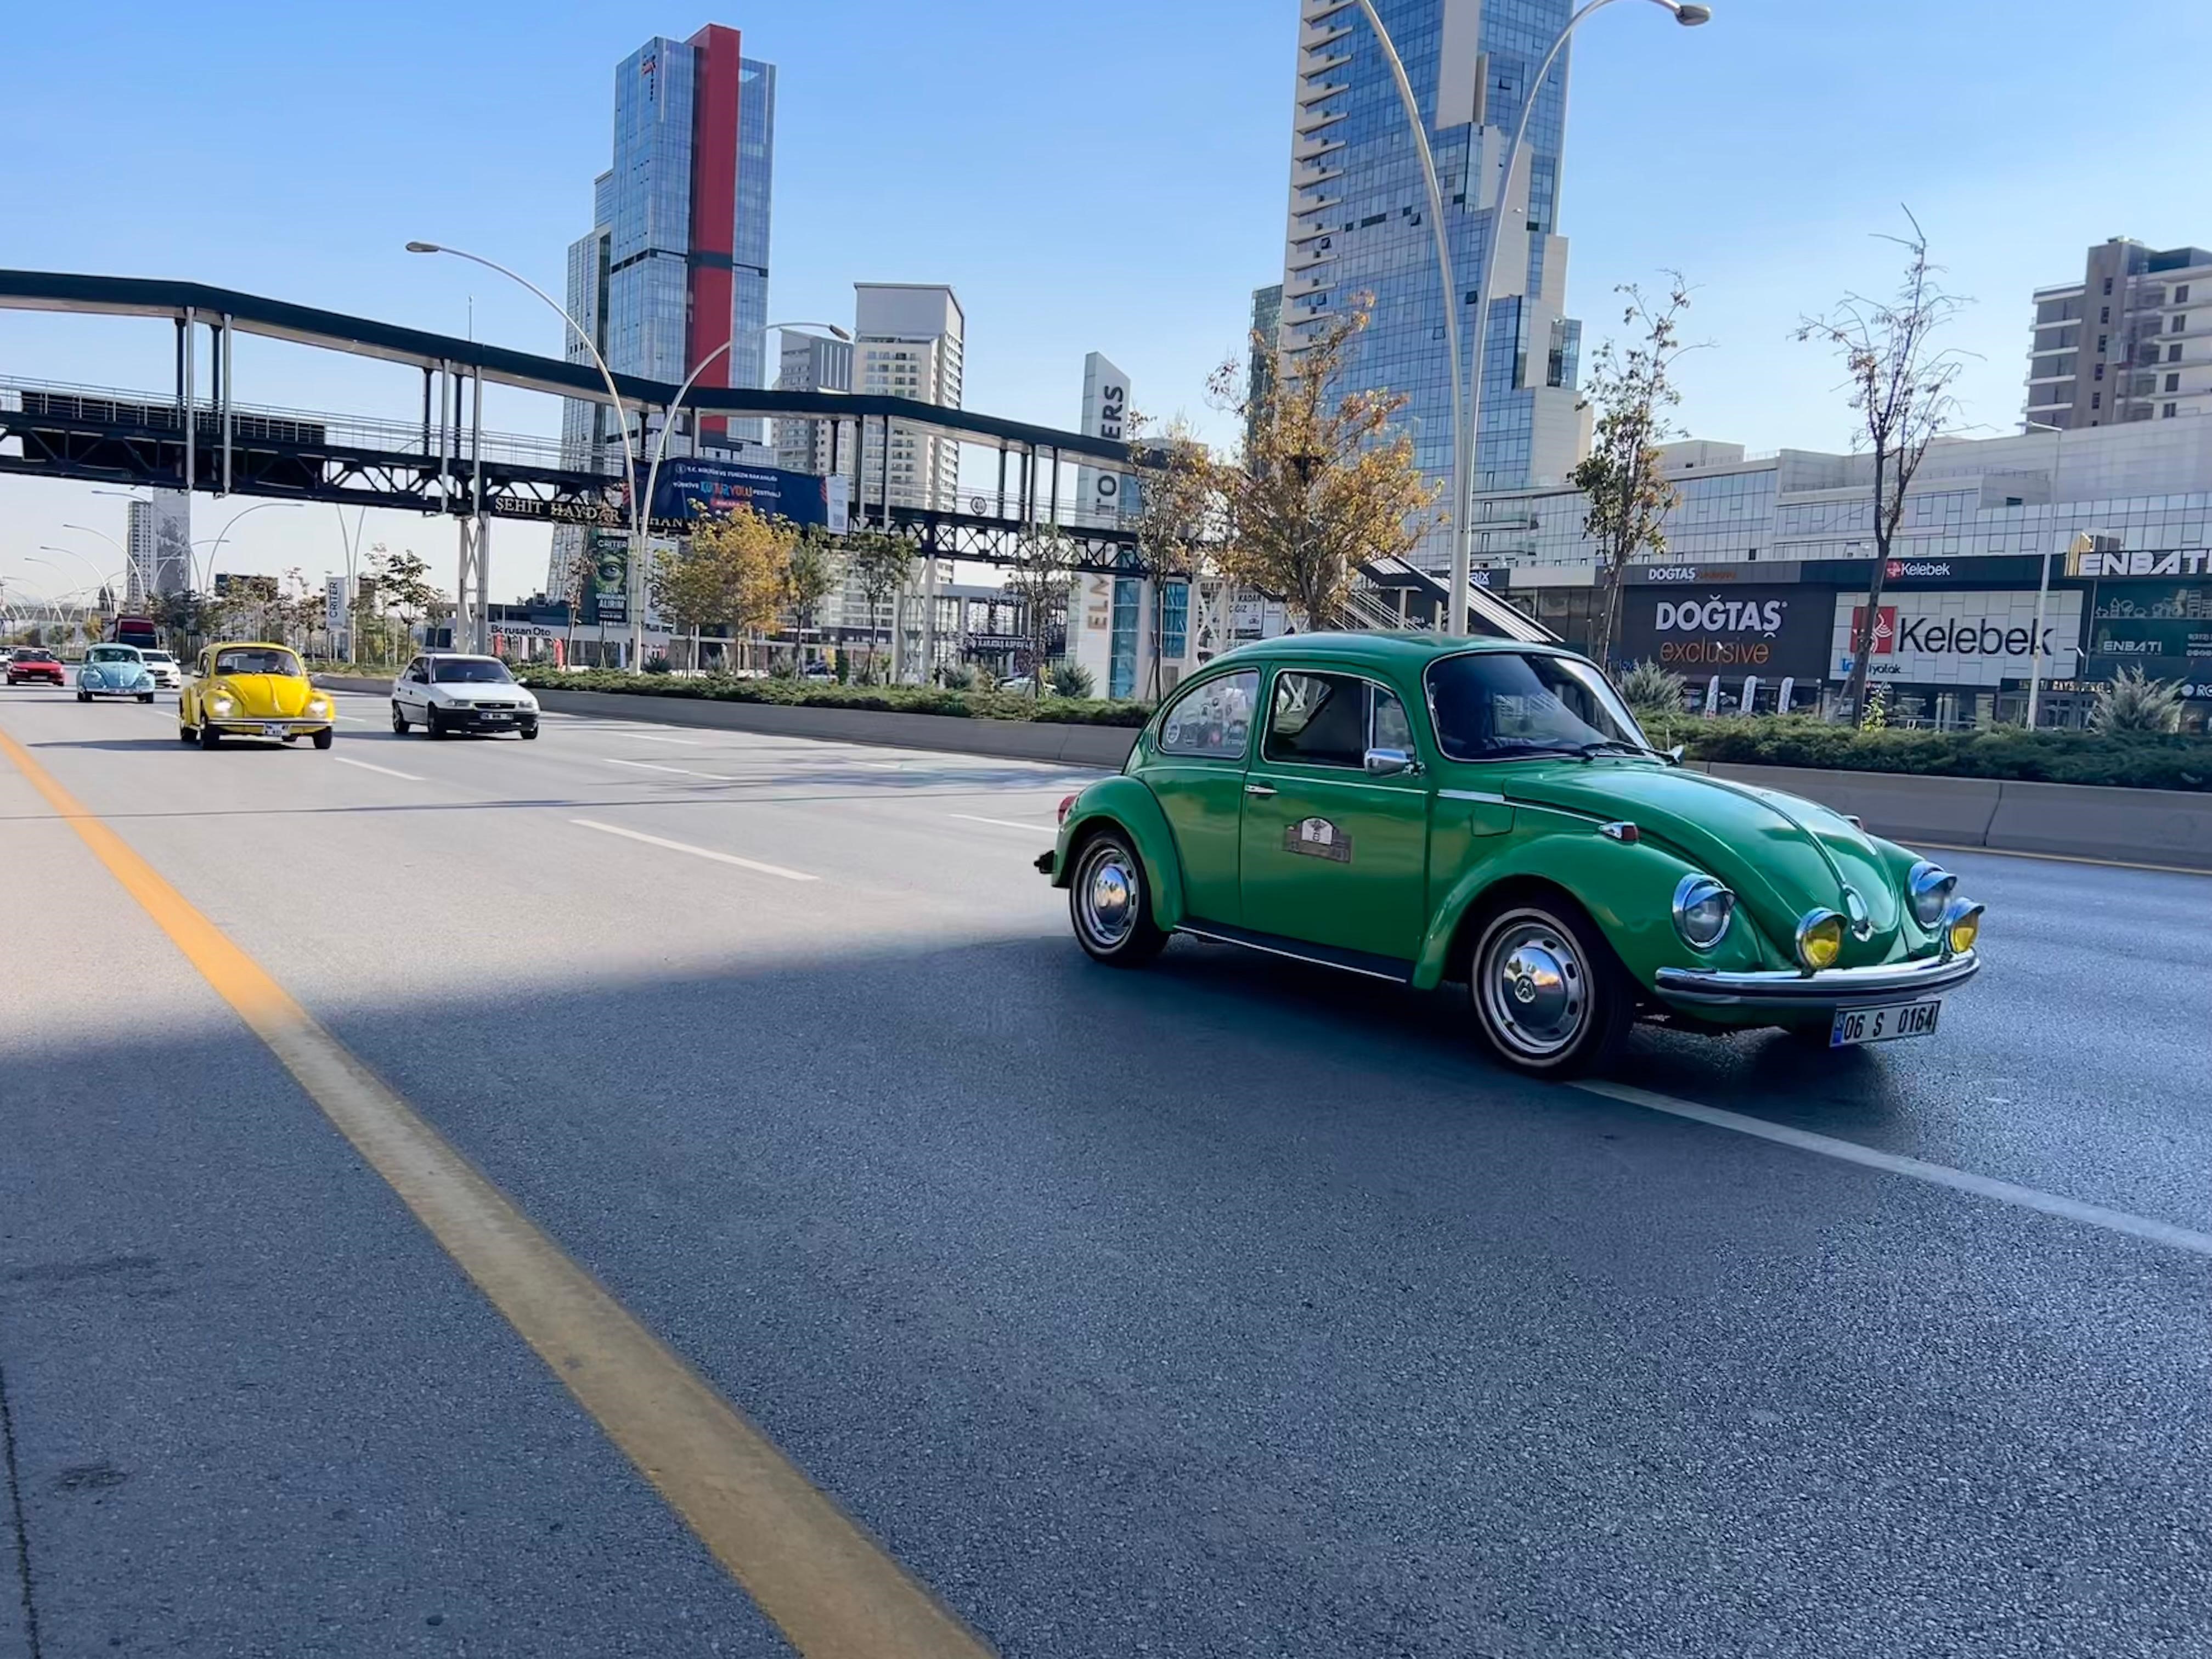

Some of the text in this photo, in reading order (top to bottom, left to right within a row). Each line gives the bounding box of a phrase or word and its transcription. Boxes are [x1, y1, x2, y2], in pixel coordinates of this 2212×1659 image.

[1096, 385, 1124, 515] TOERS
[550, 503, 622, 522] HAYDAR
[1648, 564, 1696, 583] DOĞTAŞ
[1901, 562, 1950, 575] Kelebek
[1655, 594, 1782, 637] DOĞTAŞ
[491, 624, 551, 636] Borusan Oto
[1899, 618, 2054, 656] Kelebek
[1660, 636, 1769, 664] exclusive
[2103, 641, 2162, 652] ENBATI
[1844, 1005, 1934, 1040] 06 S 0164
